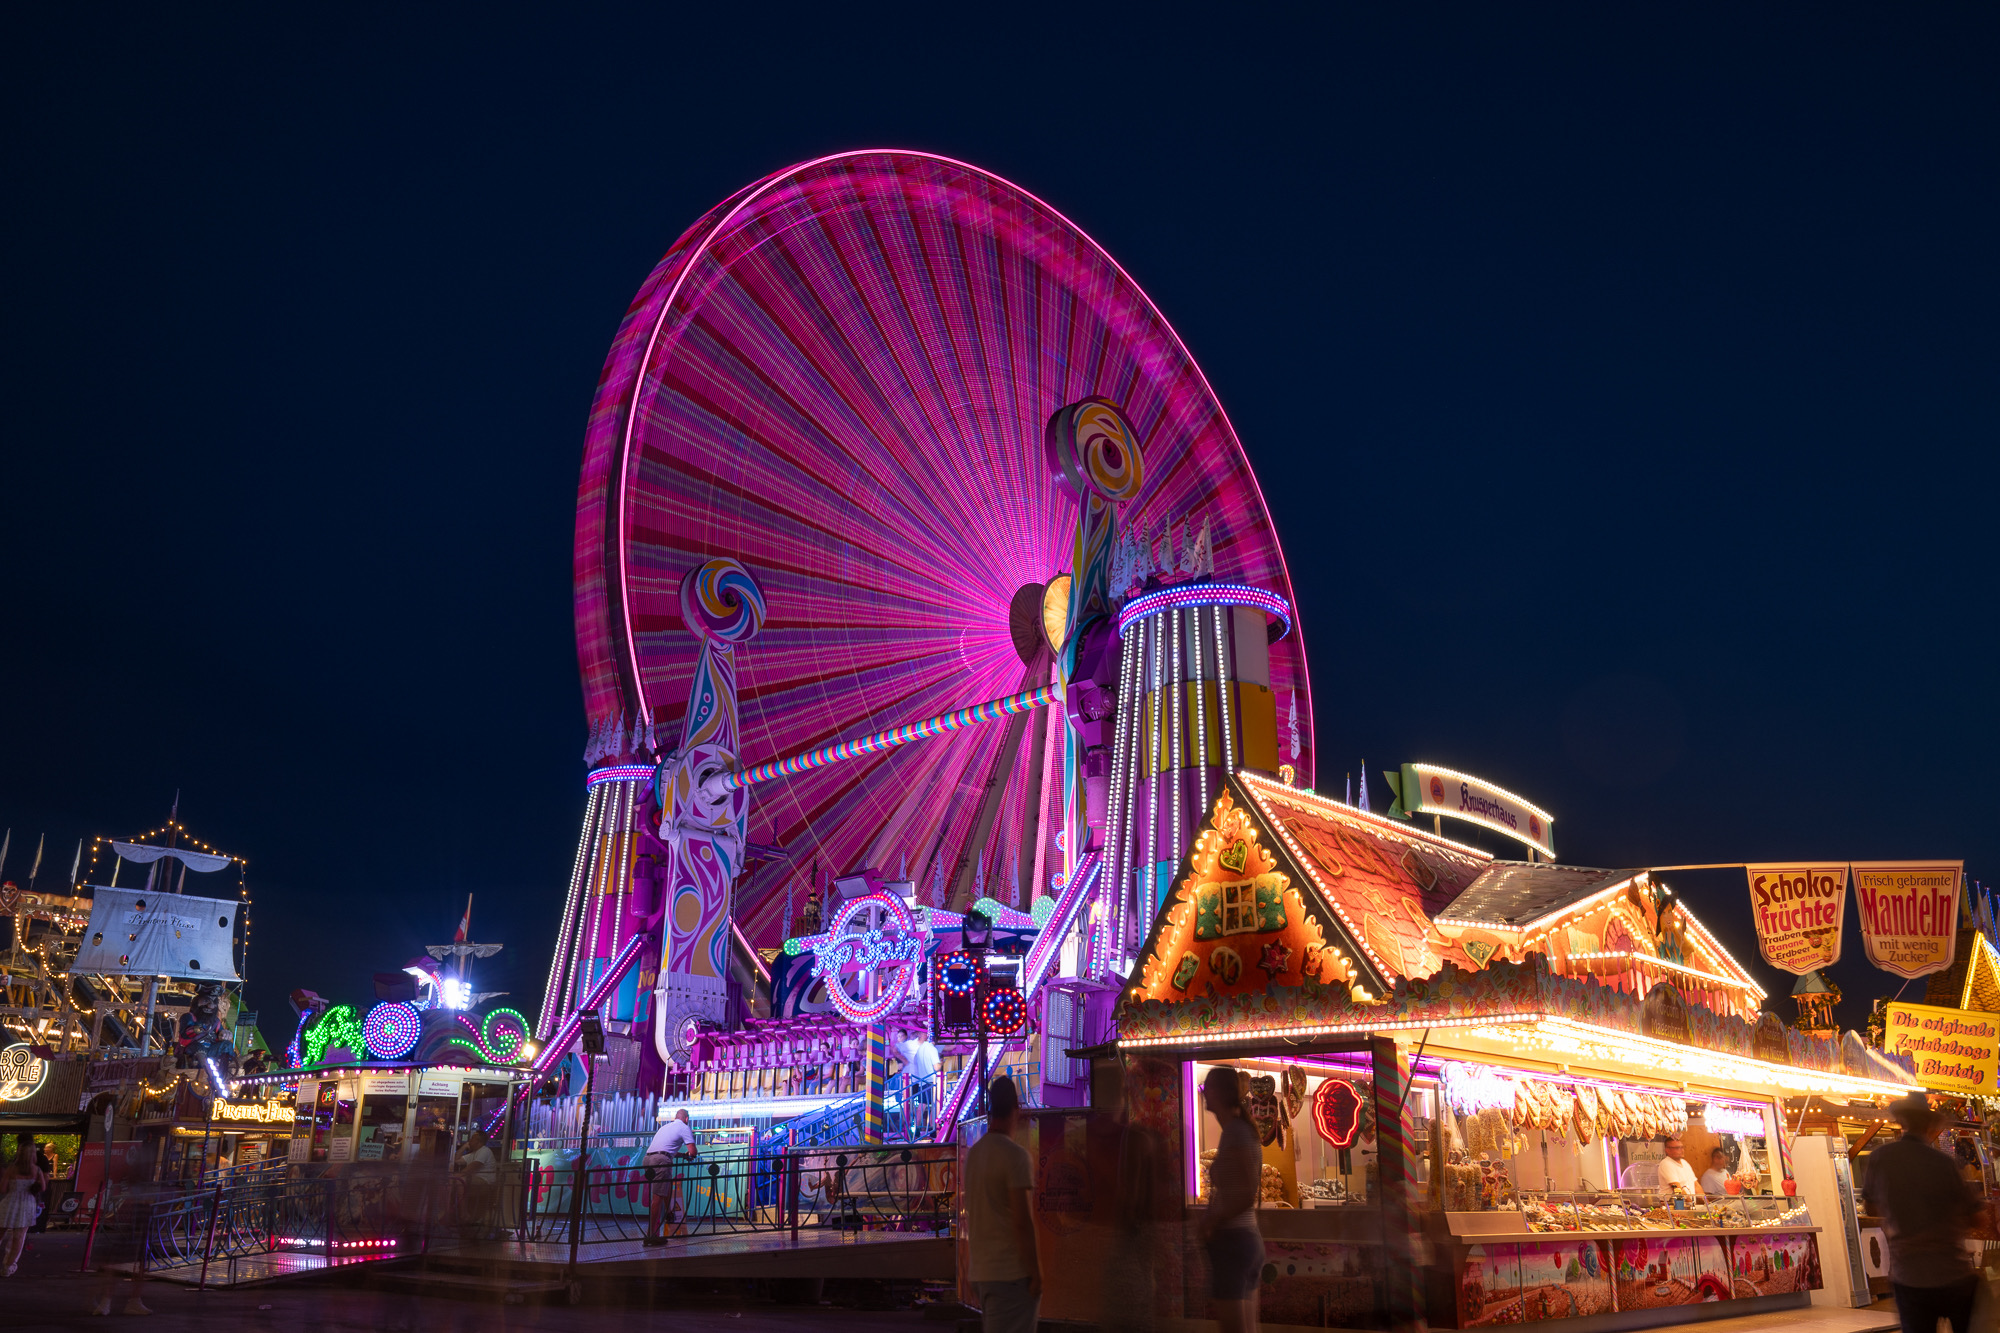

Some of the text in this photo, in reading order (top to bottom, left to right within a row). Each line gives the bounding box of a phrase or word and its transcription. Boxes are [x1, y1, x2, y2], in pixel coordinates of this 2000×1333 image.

[1754, 869, 1843, 908] Schoko-
[1863, 875, 1951, 889] Frisch gebrannte
[1760, 901, 1836, 935] früchte
[1861, 887, 1951, 937] Mandeln
[1763, 931, 1801, 945] Trauben
[1768, 939, 1804, 953] Banane
[1879, 939, 1939, 953] mit wenig
[855, 929, 921, 973] Spin
[1776, 945, 1810, 961] Erdbeer
[1787, 951, 1820, 967] Ananas
[1889, 950, 1929, 963] Zucker
[1892, 1011, 1996, 1038] Die originale
[1895, 1033, 1992, 1060] Zwiebelrose
[1, 1049, 29, 1067] BO
[1921, 1059, 1985, 1085] Bierteig
